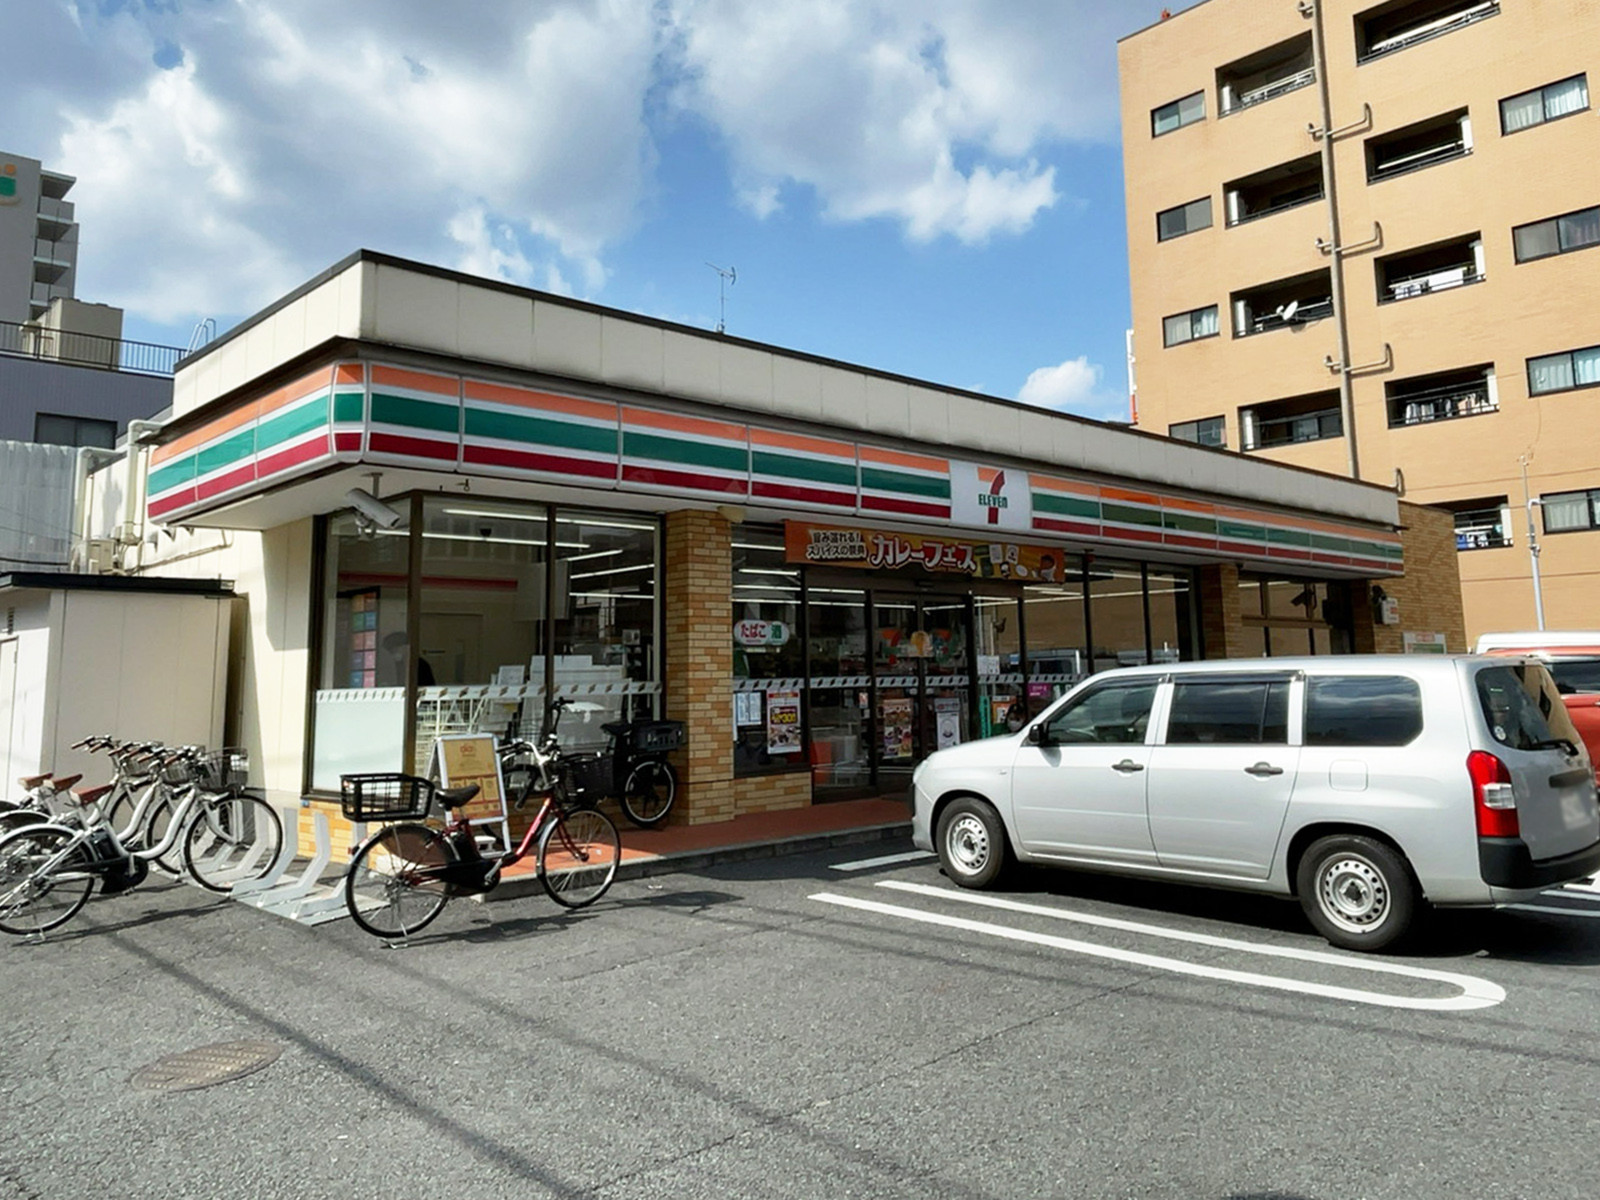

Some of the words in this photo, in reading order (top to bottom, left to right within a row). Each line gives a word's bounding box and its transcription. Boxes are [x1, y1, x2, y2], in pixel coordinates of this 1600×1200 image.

[870, 534, 977, 571] カレーフェス
[740, 622, 767, 638] たばこ
